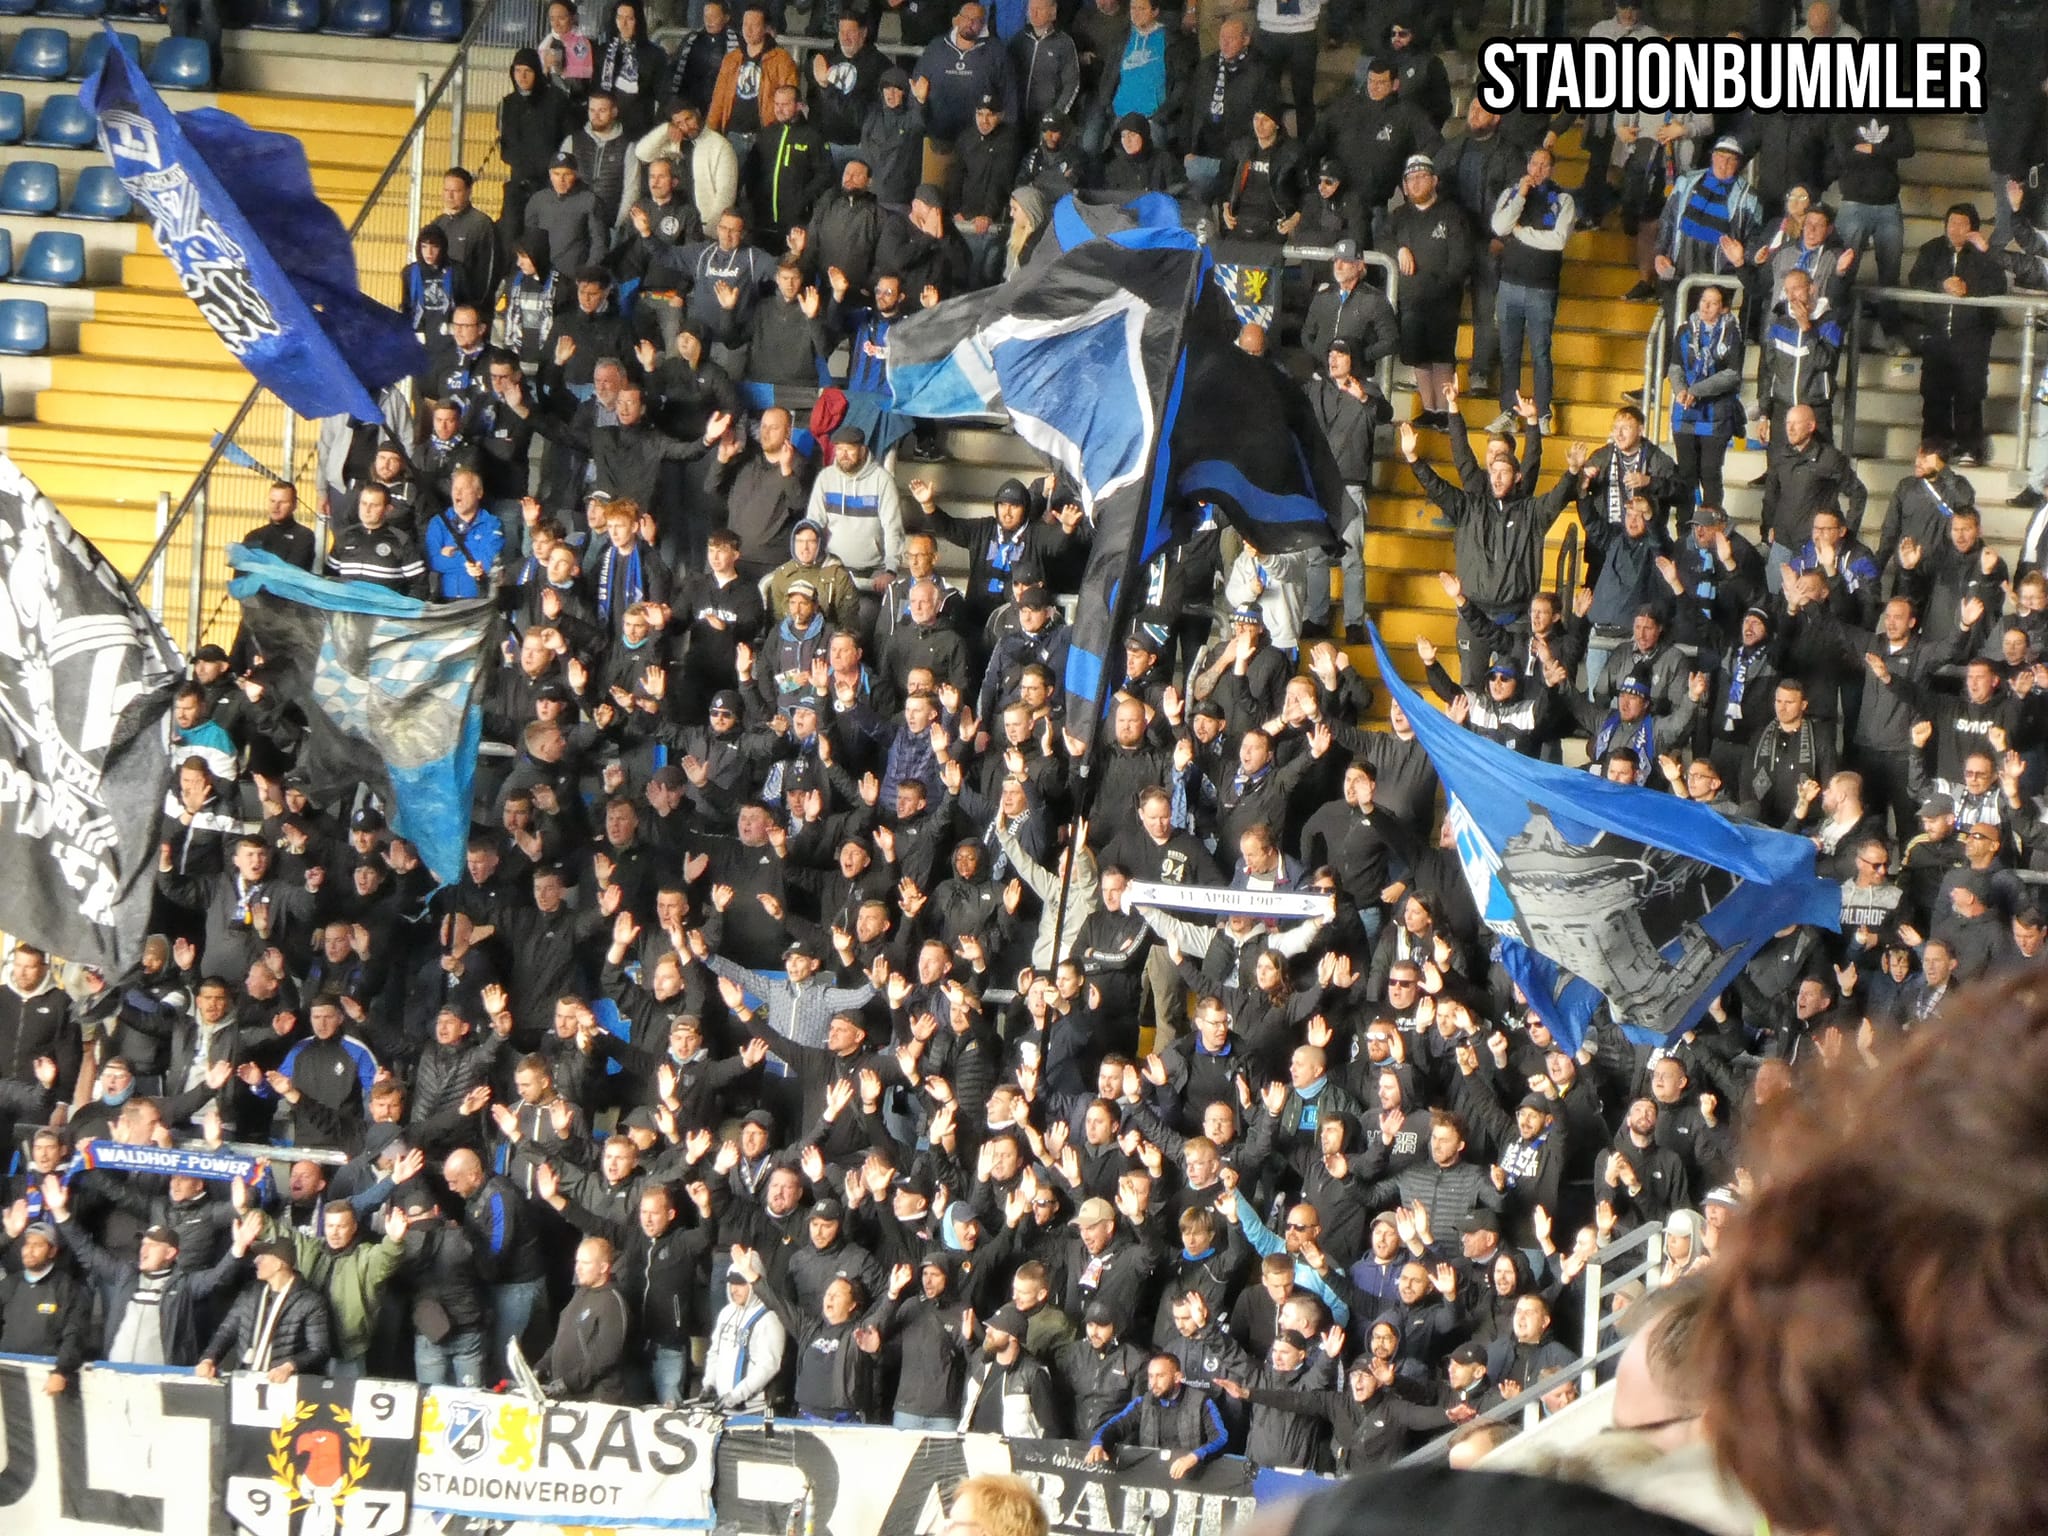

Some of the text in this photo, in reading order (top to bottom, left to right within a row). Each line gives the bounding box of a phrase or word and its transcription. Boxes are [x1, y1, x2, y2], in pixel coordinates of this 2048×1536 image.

[1161, 858, 1185, 882] 94
[96, 1147, 251, 1177] WALDHOF-POWER
[538, 1405, 698, 1476] RAS
[416, 1470, 623, 1506] STADIONVERBOT
